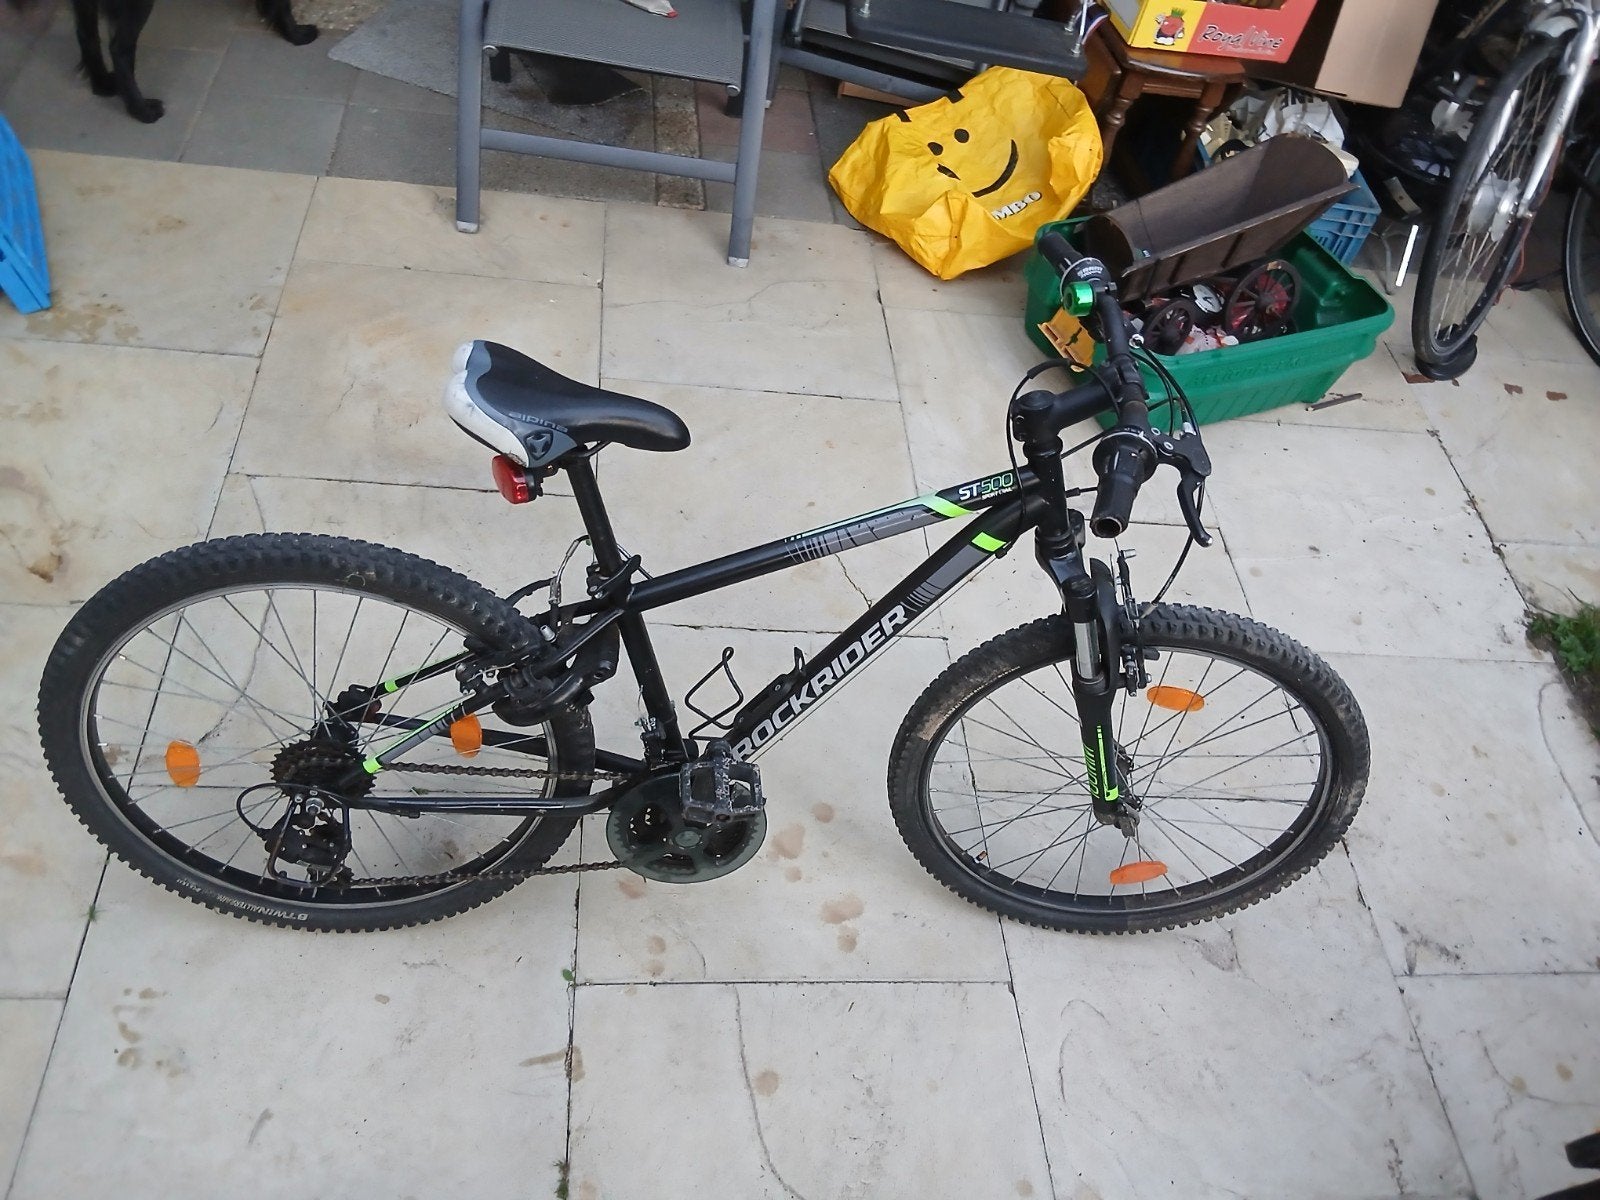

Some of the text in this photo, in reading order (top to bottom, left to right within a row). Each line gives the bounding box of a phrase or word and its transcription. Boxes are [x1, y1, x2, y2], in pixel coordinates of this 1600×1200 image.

[1197, 24, 1253, 51] Royal
[508, 411, 569, 433] alpine
[731, 604, 909, 764] ROCKRIDER
